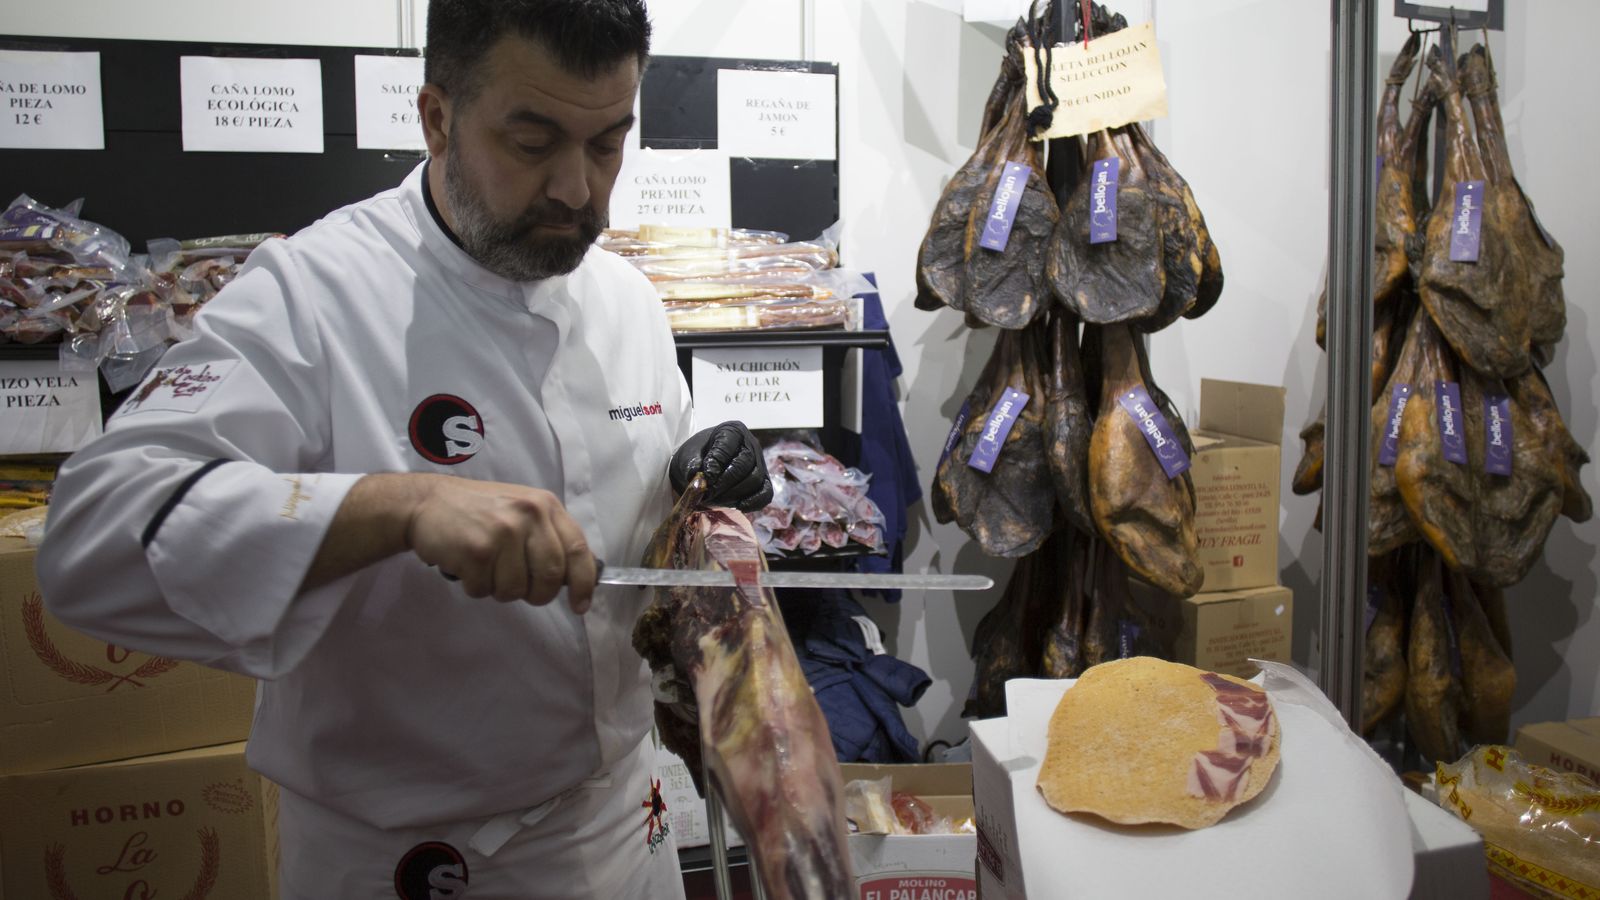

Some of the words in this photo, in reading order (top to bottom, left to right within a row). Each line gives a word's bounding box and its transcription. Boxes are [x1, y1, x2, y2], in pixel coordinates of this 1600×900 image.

[1087, 41, 1148, 66] BELLOJAN
[1060, 62, 1128, 83] SELECCION
[20, 83, 39, 94] DE
[43, 84, 86, 95] LOMO
[211, 83, 249, 96] CAÑA
[253, 86, 295, 97] LOMO
[10, 98, 52, 109] PIEZA
[207, 97, 299, 112] ECOLÓGICA
[745, 97, 793, 109] REGAÑA
[796, 101, 810, 110] DE
[15, 113, 29, 125] 12
[33, 113, 42, 125] €
[215, 116, 229, 127] 18
[248, 117, 293, 128] PIEZA
[391, 113, 398, 123] 5
[758, 112, 799, 121] JAMON
[771, 126, 777, 136] 5
[779, 126, 786, 136] €
[634, 173, 668, 185] CAÑA
[671, 175, 707, 185] LOMO
[640, 189, 701, 200] PREMIUN
[991, 174, 1018, 221] bellojan
[1093, 170, 1111, 214] bellojan
[637, 204, 650, 215] 27
[667, 204, 705, 215] PIEZA
[1456, 194, 1474, 235] bellojan
[716, 358, 800, 373] SALCHICHÓN
[0, 377, 29, 389] IZO
[33, 375, 79, 388] VELA
[735, 376, 780, 388] CULAR
[7, 394, 61, 408] PIEZA
[725, 394, 732, 403] 6
[749, 391, 791, 402] PIEZA
[983, 400, 1015, 443] bellojan
[1443, 395, 1459, 436] bellojan
[1133, 403, 1166, 449] bellojan
[1491, 405, 1505, 446] bellojan
[1221, 533, 1263, 548] FRAGIL
[71, 799, 185, 827] HORNO
[96, 831, 158, 875] La
[899, 879, 947, 888] MOLINO
